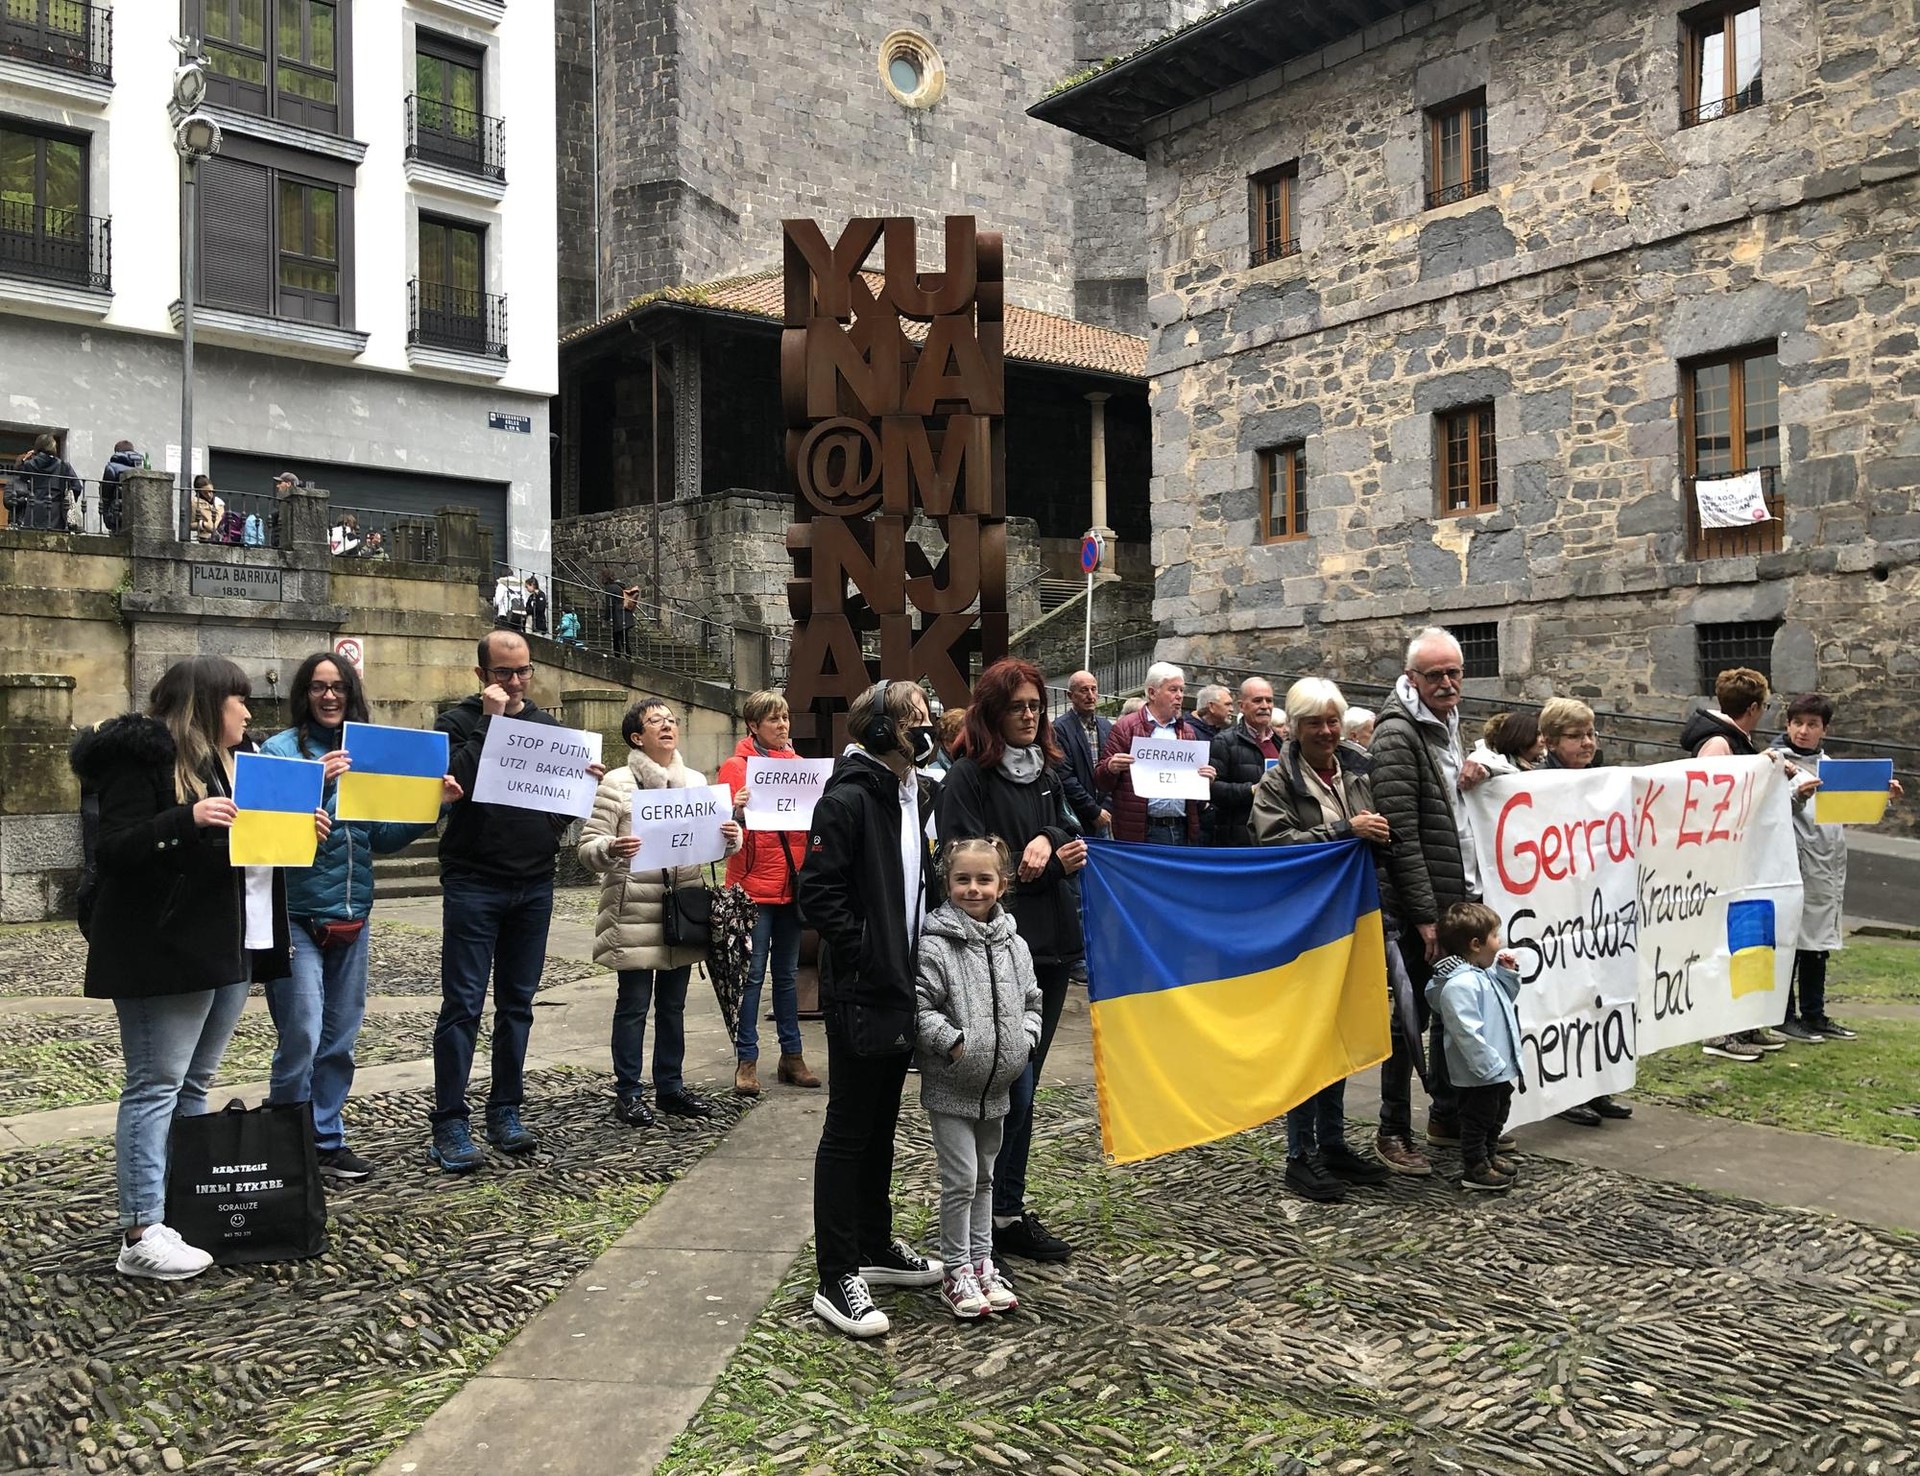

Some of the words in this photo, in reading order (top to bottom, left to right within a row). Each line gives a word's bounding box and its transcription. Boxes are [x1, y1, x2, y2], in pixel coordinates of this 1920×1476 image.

[194, 566, 229, 580] PLAZA
[233, 569, 279, 584] BARRIXA
[222, 586, 247, 597] 1830
[507, 734, 544, 750] STOP
[550, 741, 593, 761] PUTIN,
[1136, 748, 1196, 763] GERRARIK
[500, 756, 527, 770] UTZI
[535, 762, 584, 780] BAKEAN
[754, 771, 820, 785] GERRARIK
[1159, 772, 1177, 783] EZ!
[507, 780, 571, 800] UKRAINIA!
[641, 801, 717, 821] GERRARIK
[777, 798, 796, 812] EZ!
[1676, 771, 1756, 850] EZ!!
[671, 832, 694, 848] EZ!
[1654, 946, 1701, 1021] bat
[235, 1179, 284, 1193] ETXABE
[218, 1201, 258, 1212] SORALUZE
